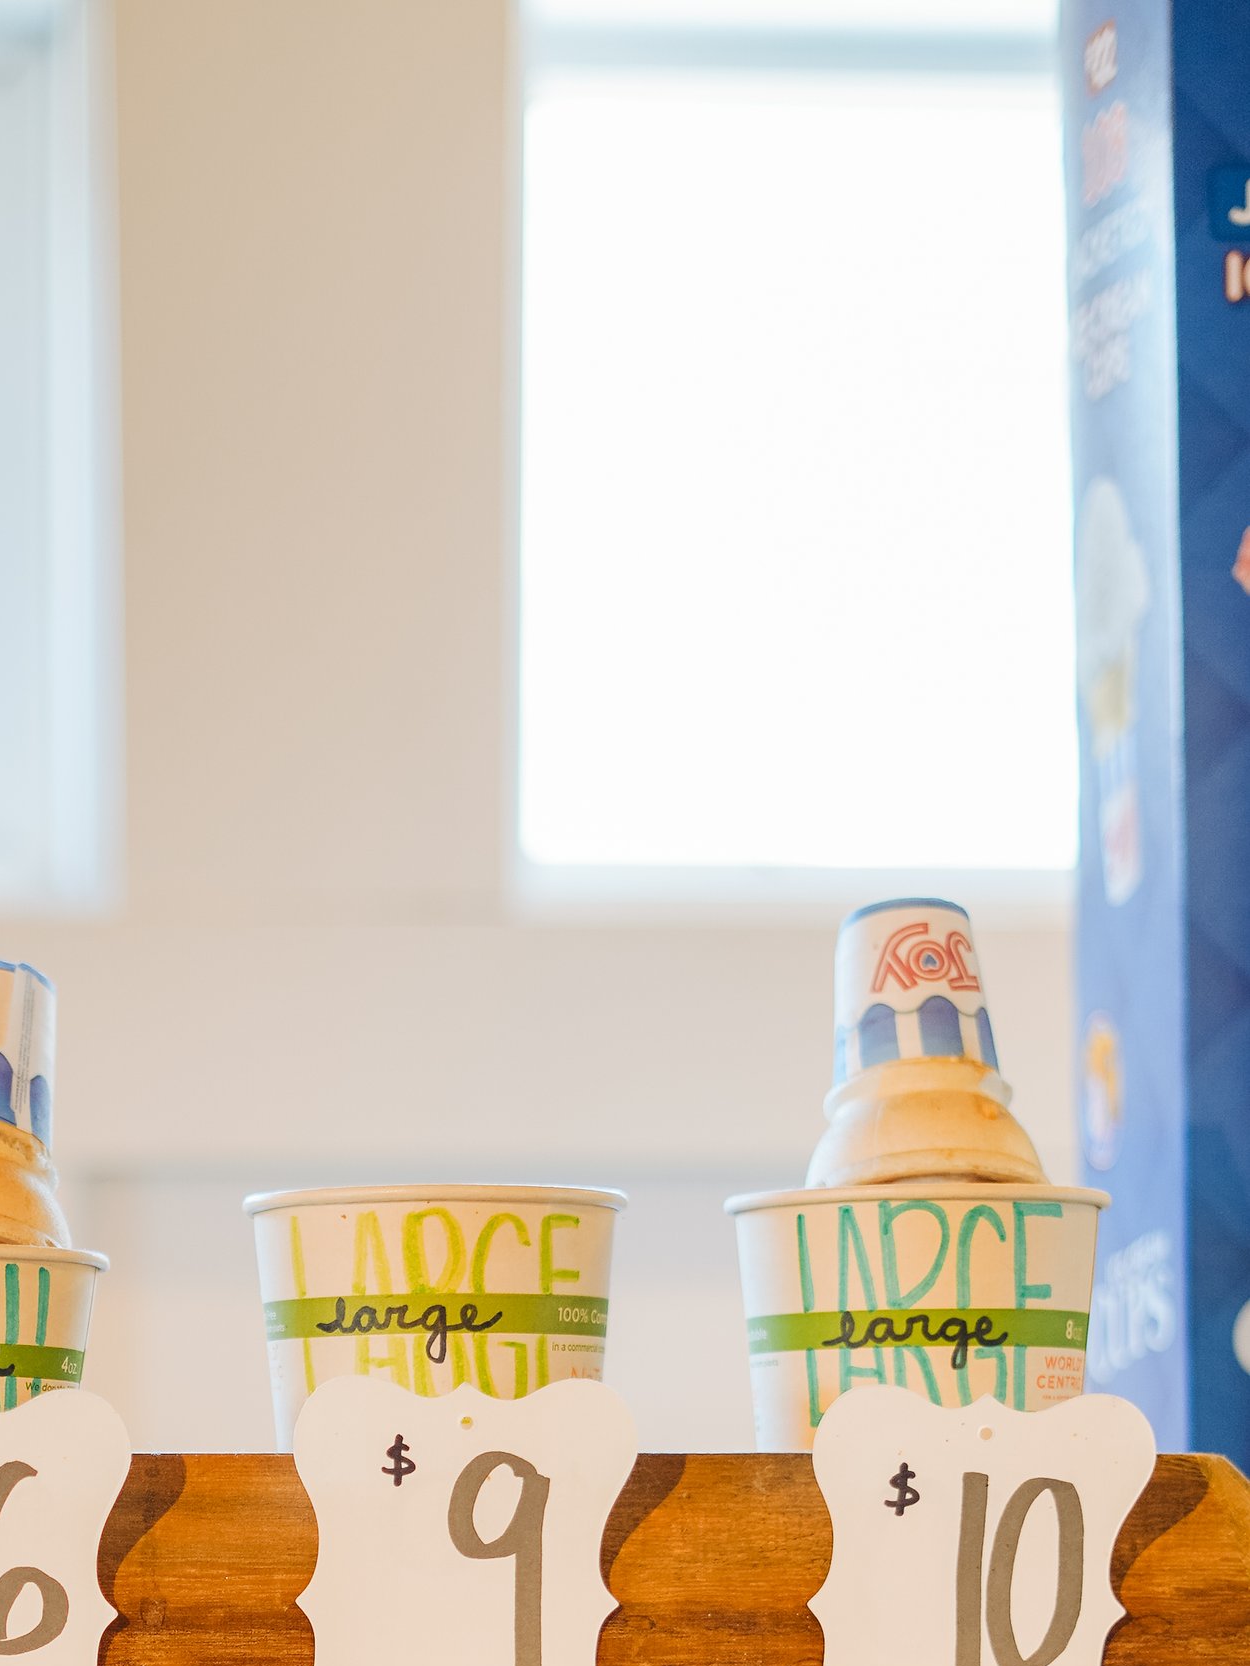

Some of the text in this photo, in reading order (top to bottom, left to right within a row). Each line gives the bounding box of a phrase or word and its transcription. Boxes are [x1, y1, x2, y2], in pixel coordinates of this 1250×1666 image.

[316, 1296, 503, 1364] large
[557, 1307, 588, 1324] 100%
[821, 1310, 1008, 1370] large
[382, 1434, 416, 1486] $
[884, 1463, 920, 1516] $
